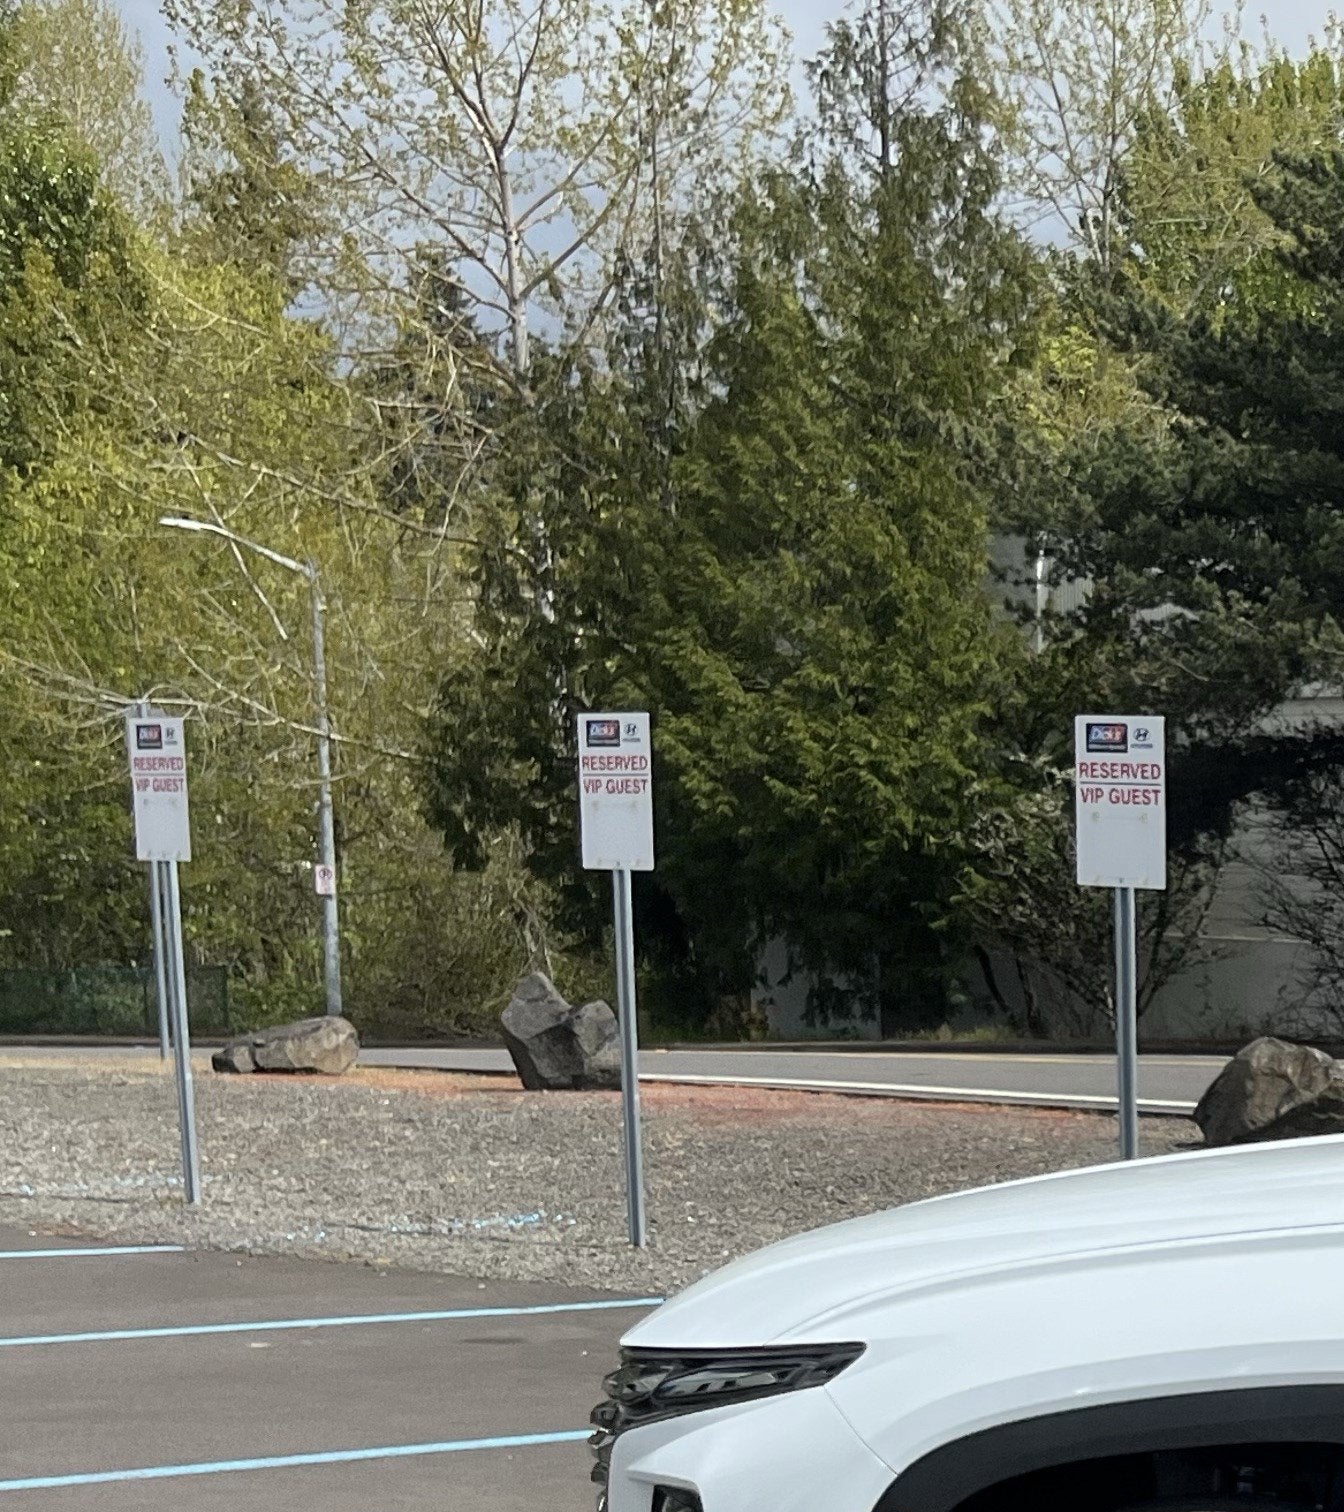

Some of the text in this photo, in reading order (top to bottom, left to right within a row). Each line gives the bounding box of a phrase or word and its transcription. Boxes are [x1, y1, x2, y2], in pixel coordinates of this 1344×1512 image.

[582, 756, 648, 770] RESERVED
[1079, 762, 1161, 779] RESERVED
[584, 779, 647, 794] VIP GUEST
[1081, 788, 1161, 805] VIP GUEST
